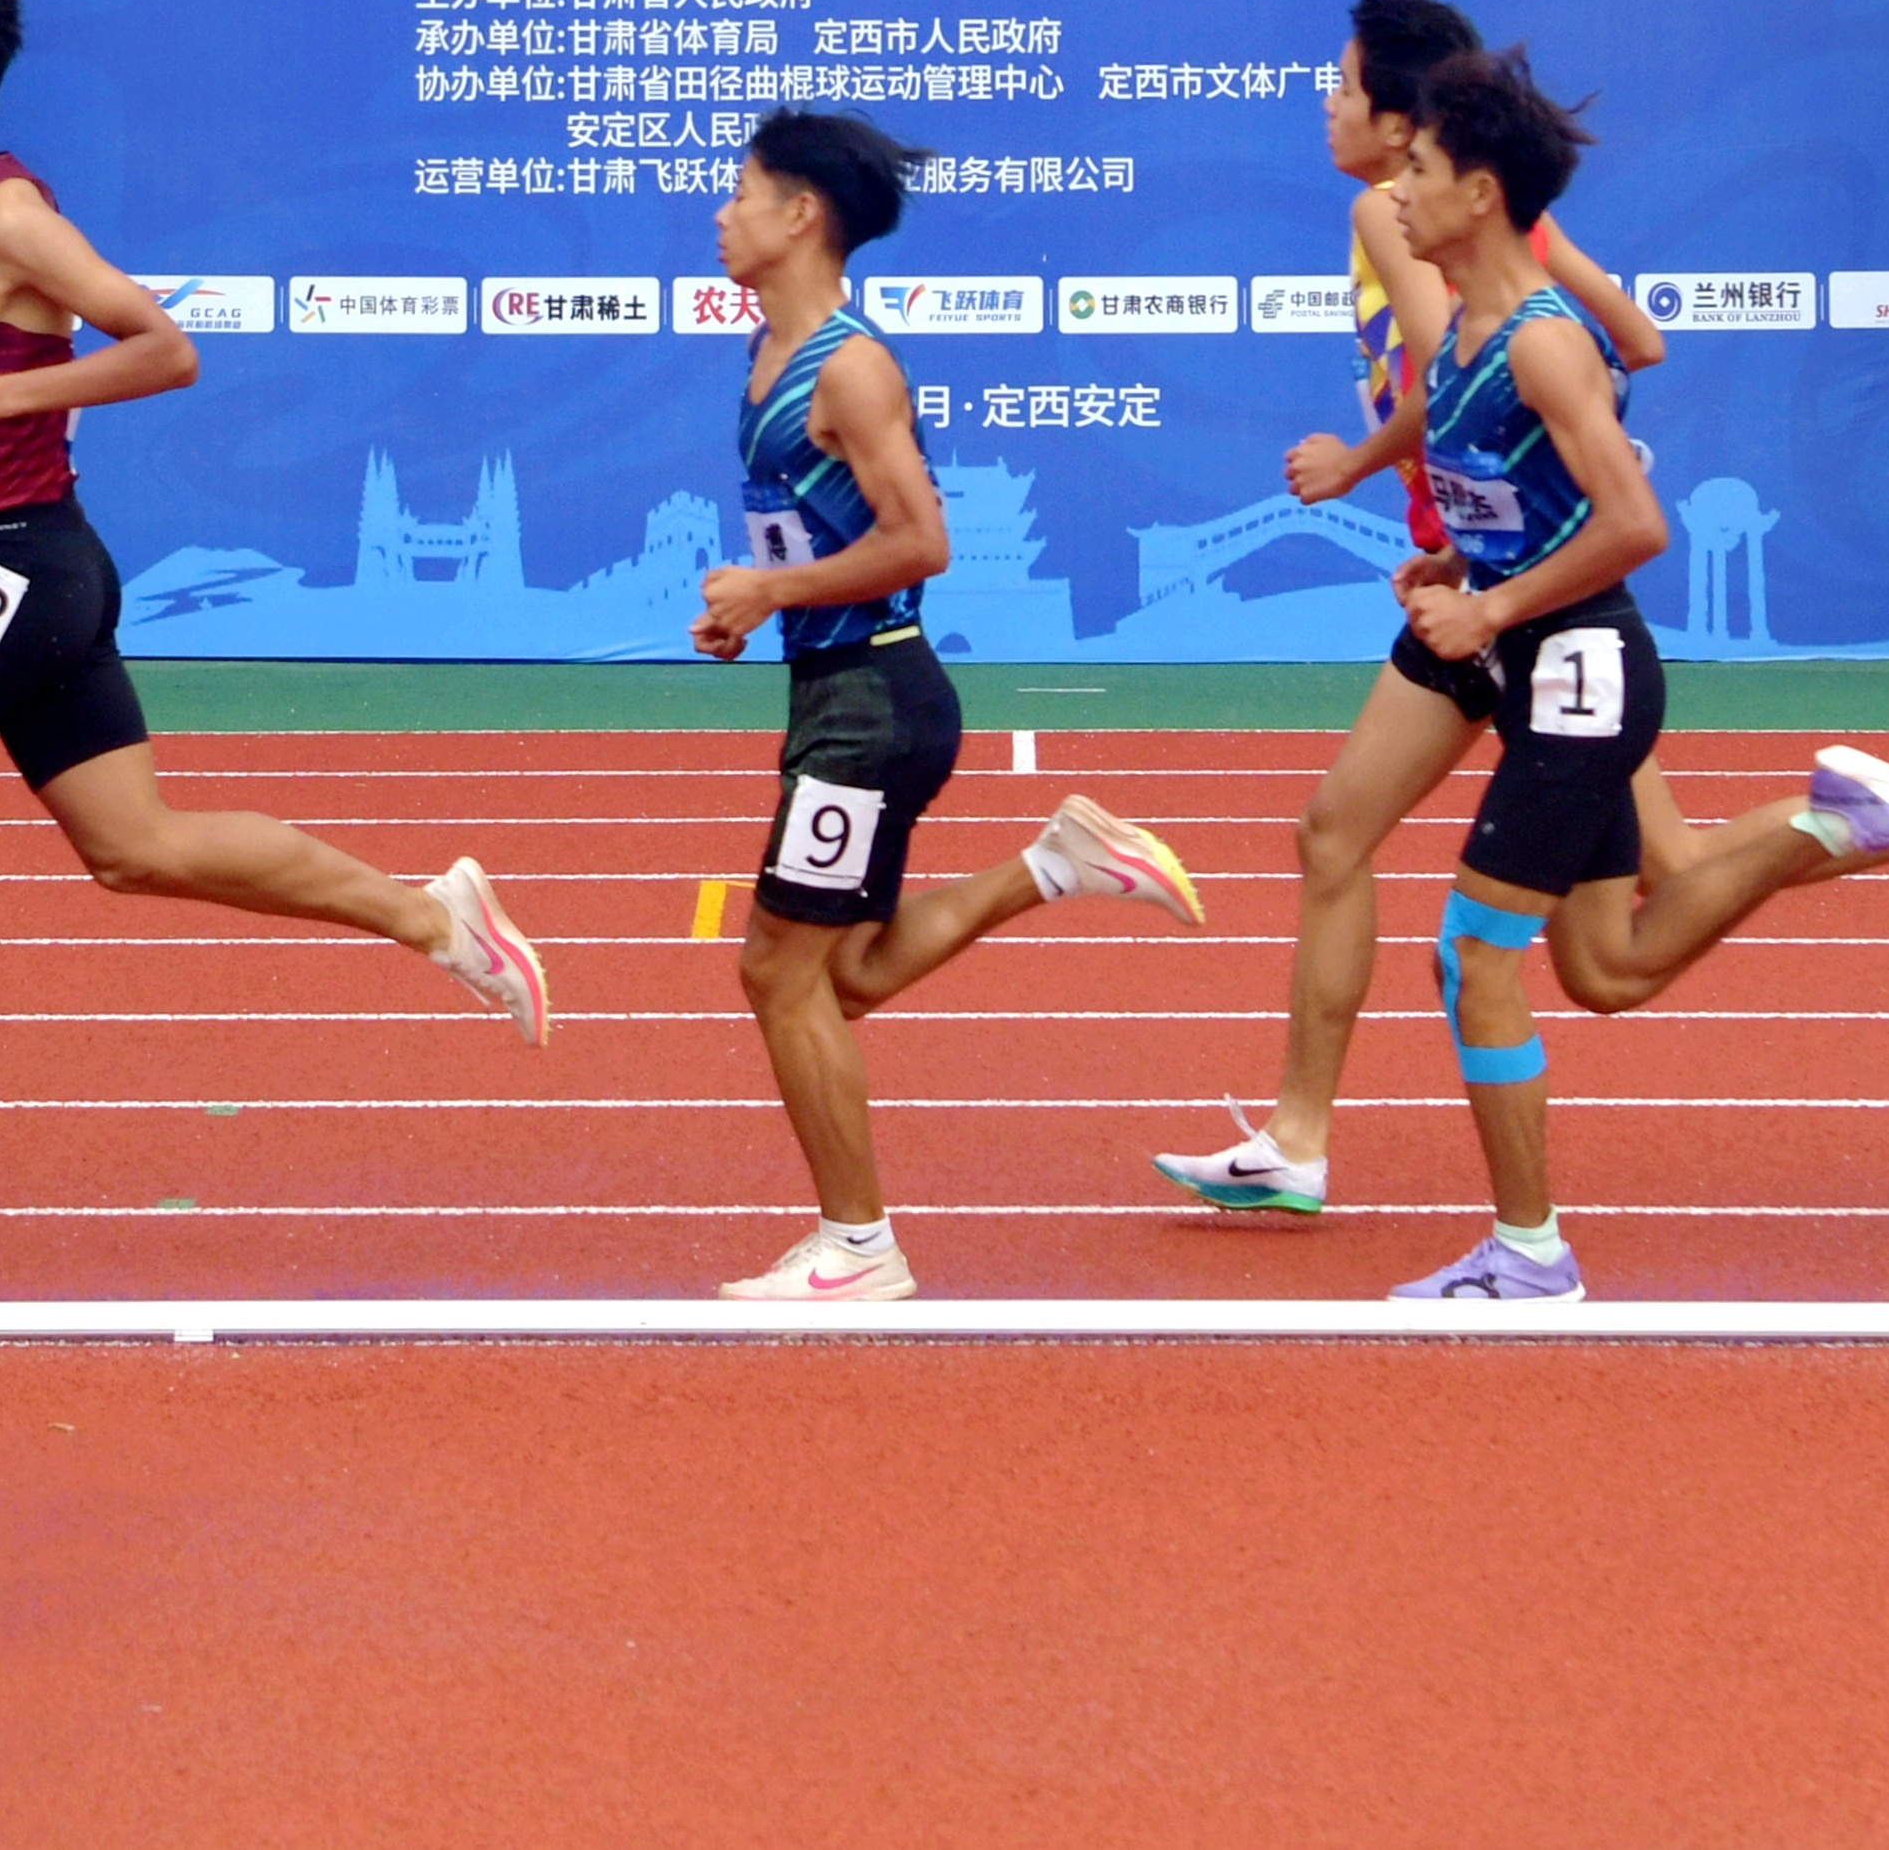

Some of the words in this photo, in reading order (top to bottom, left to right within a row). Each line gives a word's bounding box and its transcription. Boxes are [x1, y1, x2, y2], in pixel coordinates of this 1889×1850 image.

[814, 17, 1062, 55] 定西市人民政府
[340, 295, 458, 315] 中国体育彩票
[931, 289, 1025, 311] 飞跃体育
[1101, 294, 1228, 316] 甘肃农商银行
[1692, 281, 1802, 309] 兰州银行
[190, 308, 242, 318] GCAG
[544, 294, 647, 321] 甘肃稀土
[929, 314, 969, 322] FEIYUE
[975, 314, 1022, 322] SPORTS
[1692, 313, 1724, 323] BANK
[1726, 313, 1742, 323] OF
[1559, 651, 1596, 717] 1
[805, 805, 852, 869] 9
